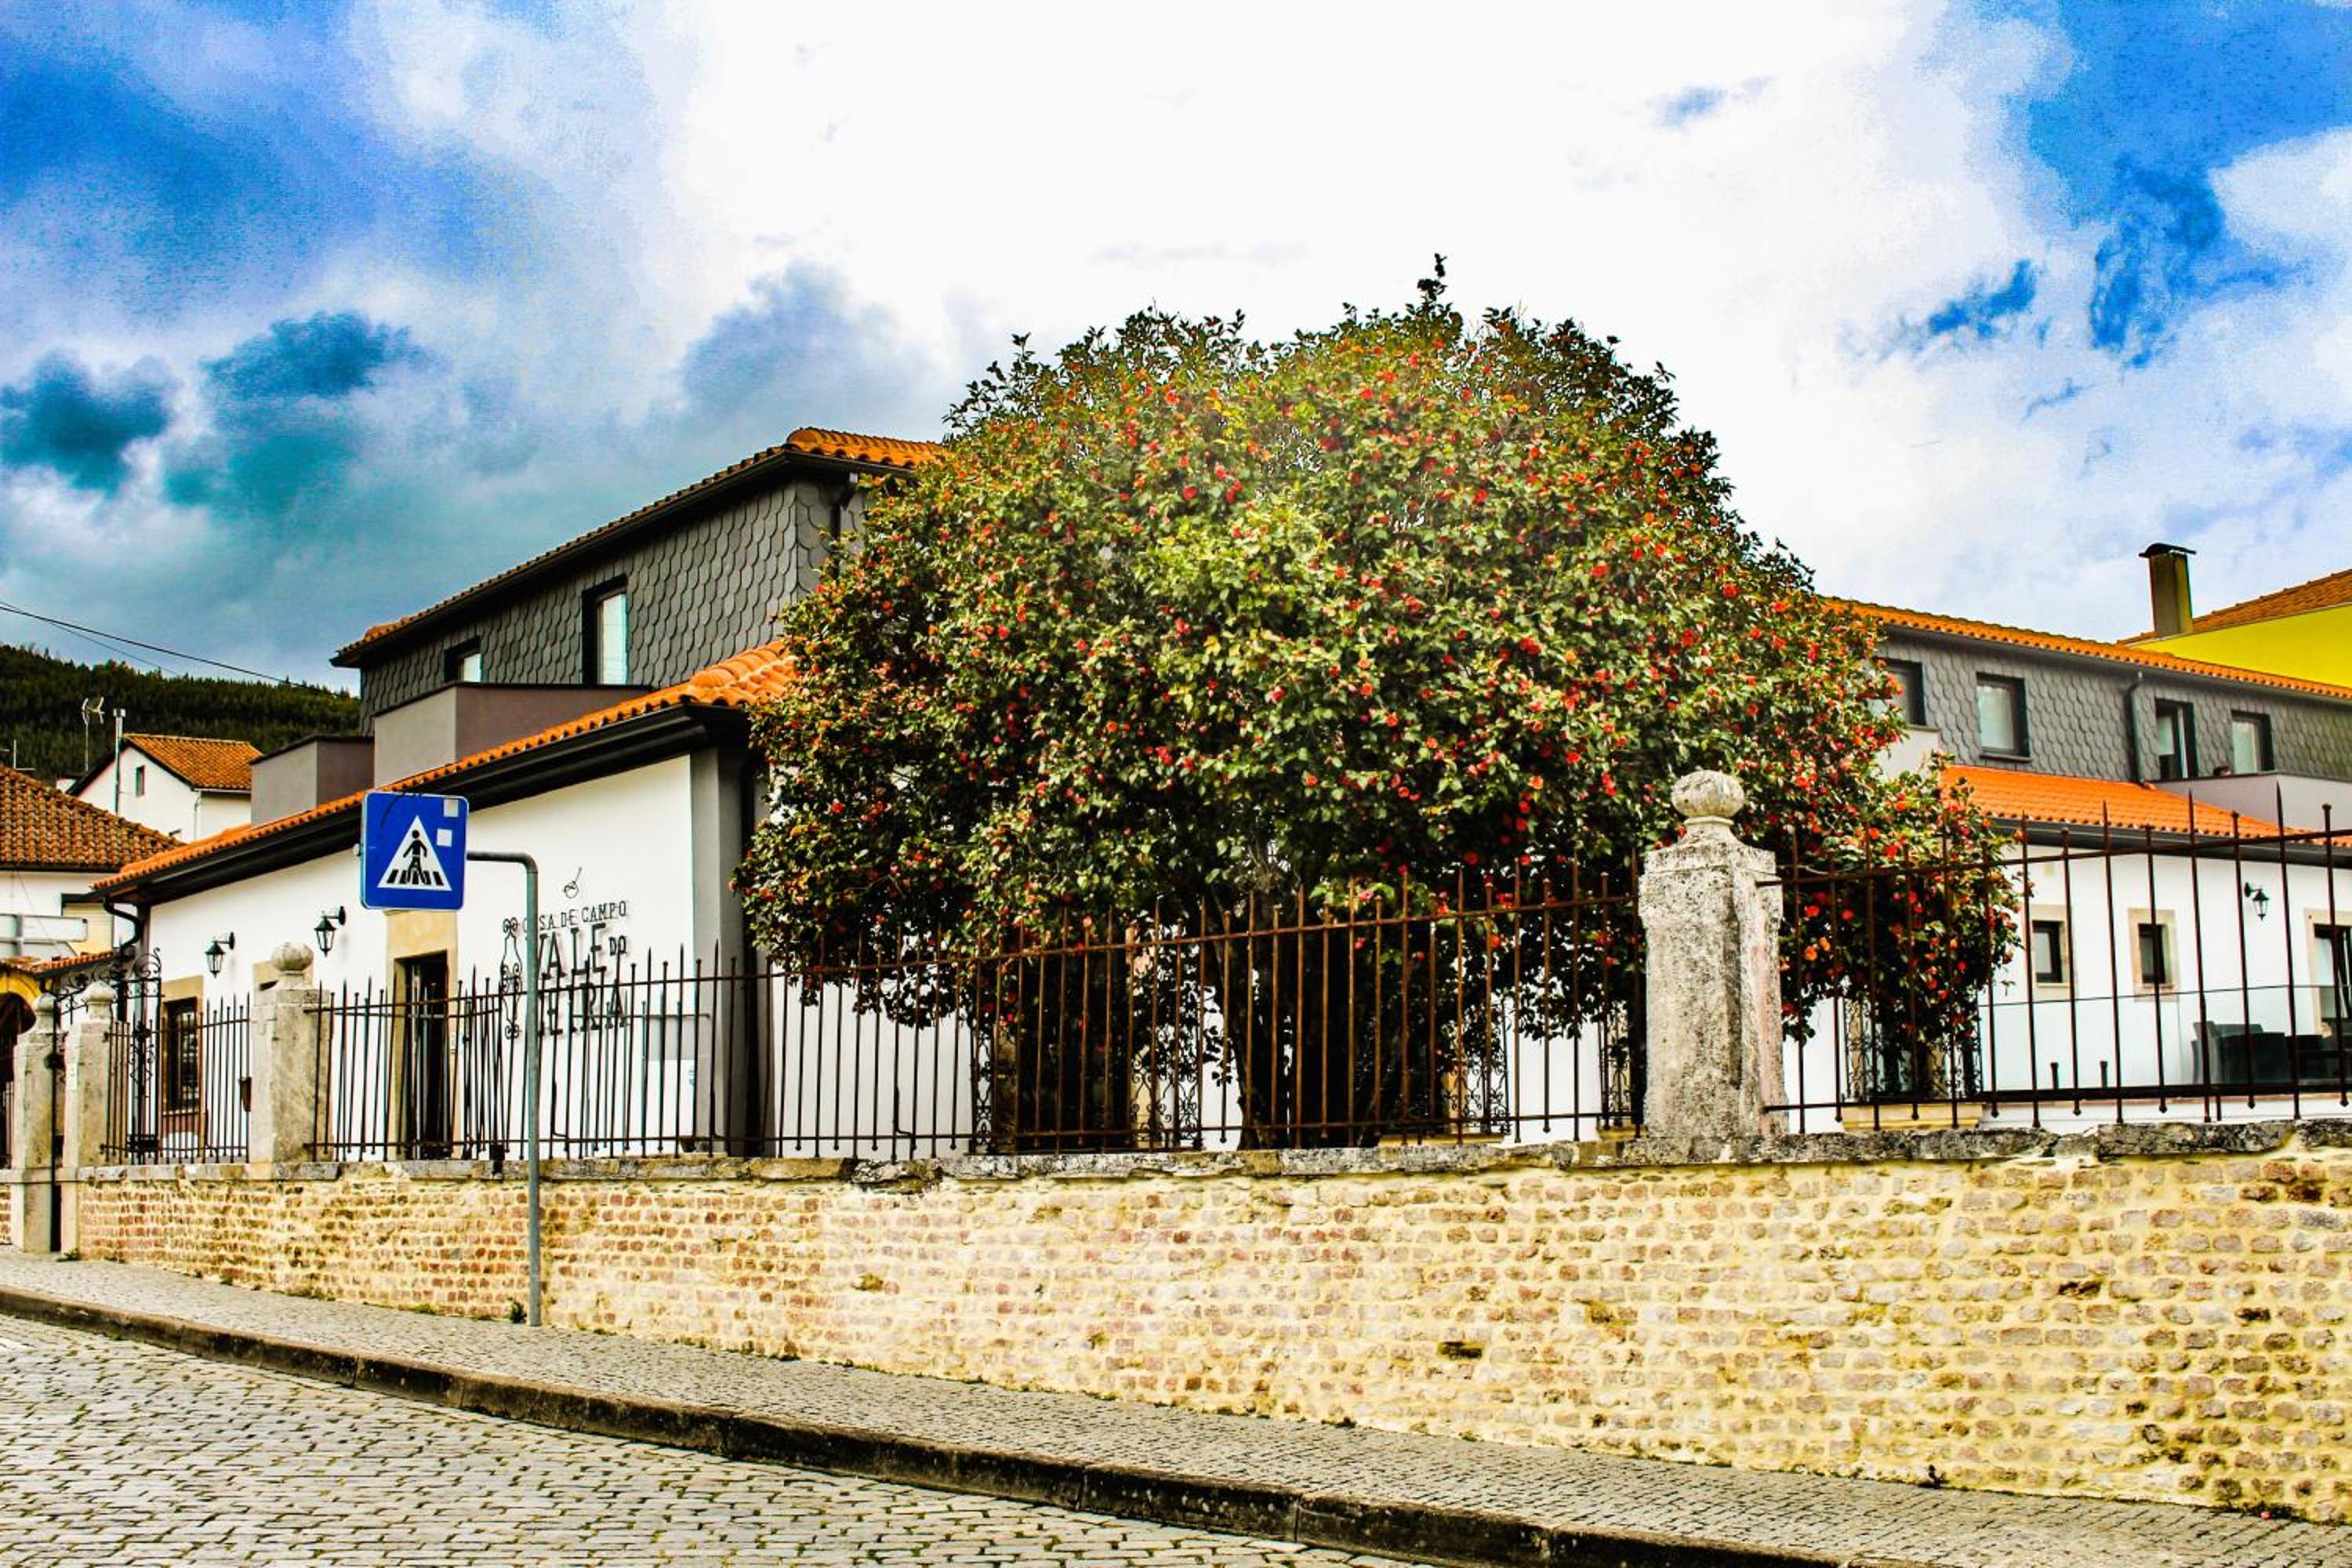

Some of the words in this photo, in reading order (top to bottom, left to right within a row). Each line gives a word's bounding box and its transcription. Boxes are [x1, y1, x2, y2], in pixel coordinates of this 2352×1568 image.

[523, 914, 559, 933] CSA
[561, 909, 579, 927] DE
[582, 900, 627, 923] CAMPO
[608, 935, 628, 956] DO
